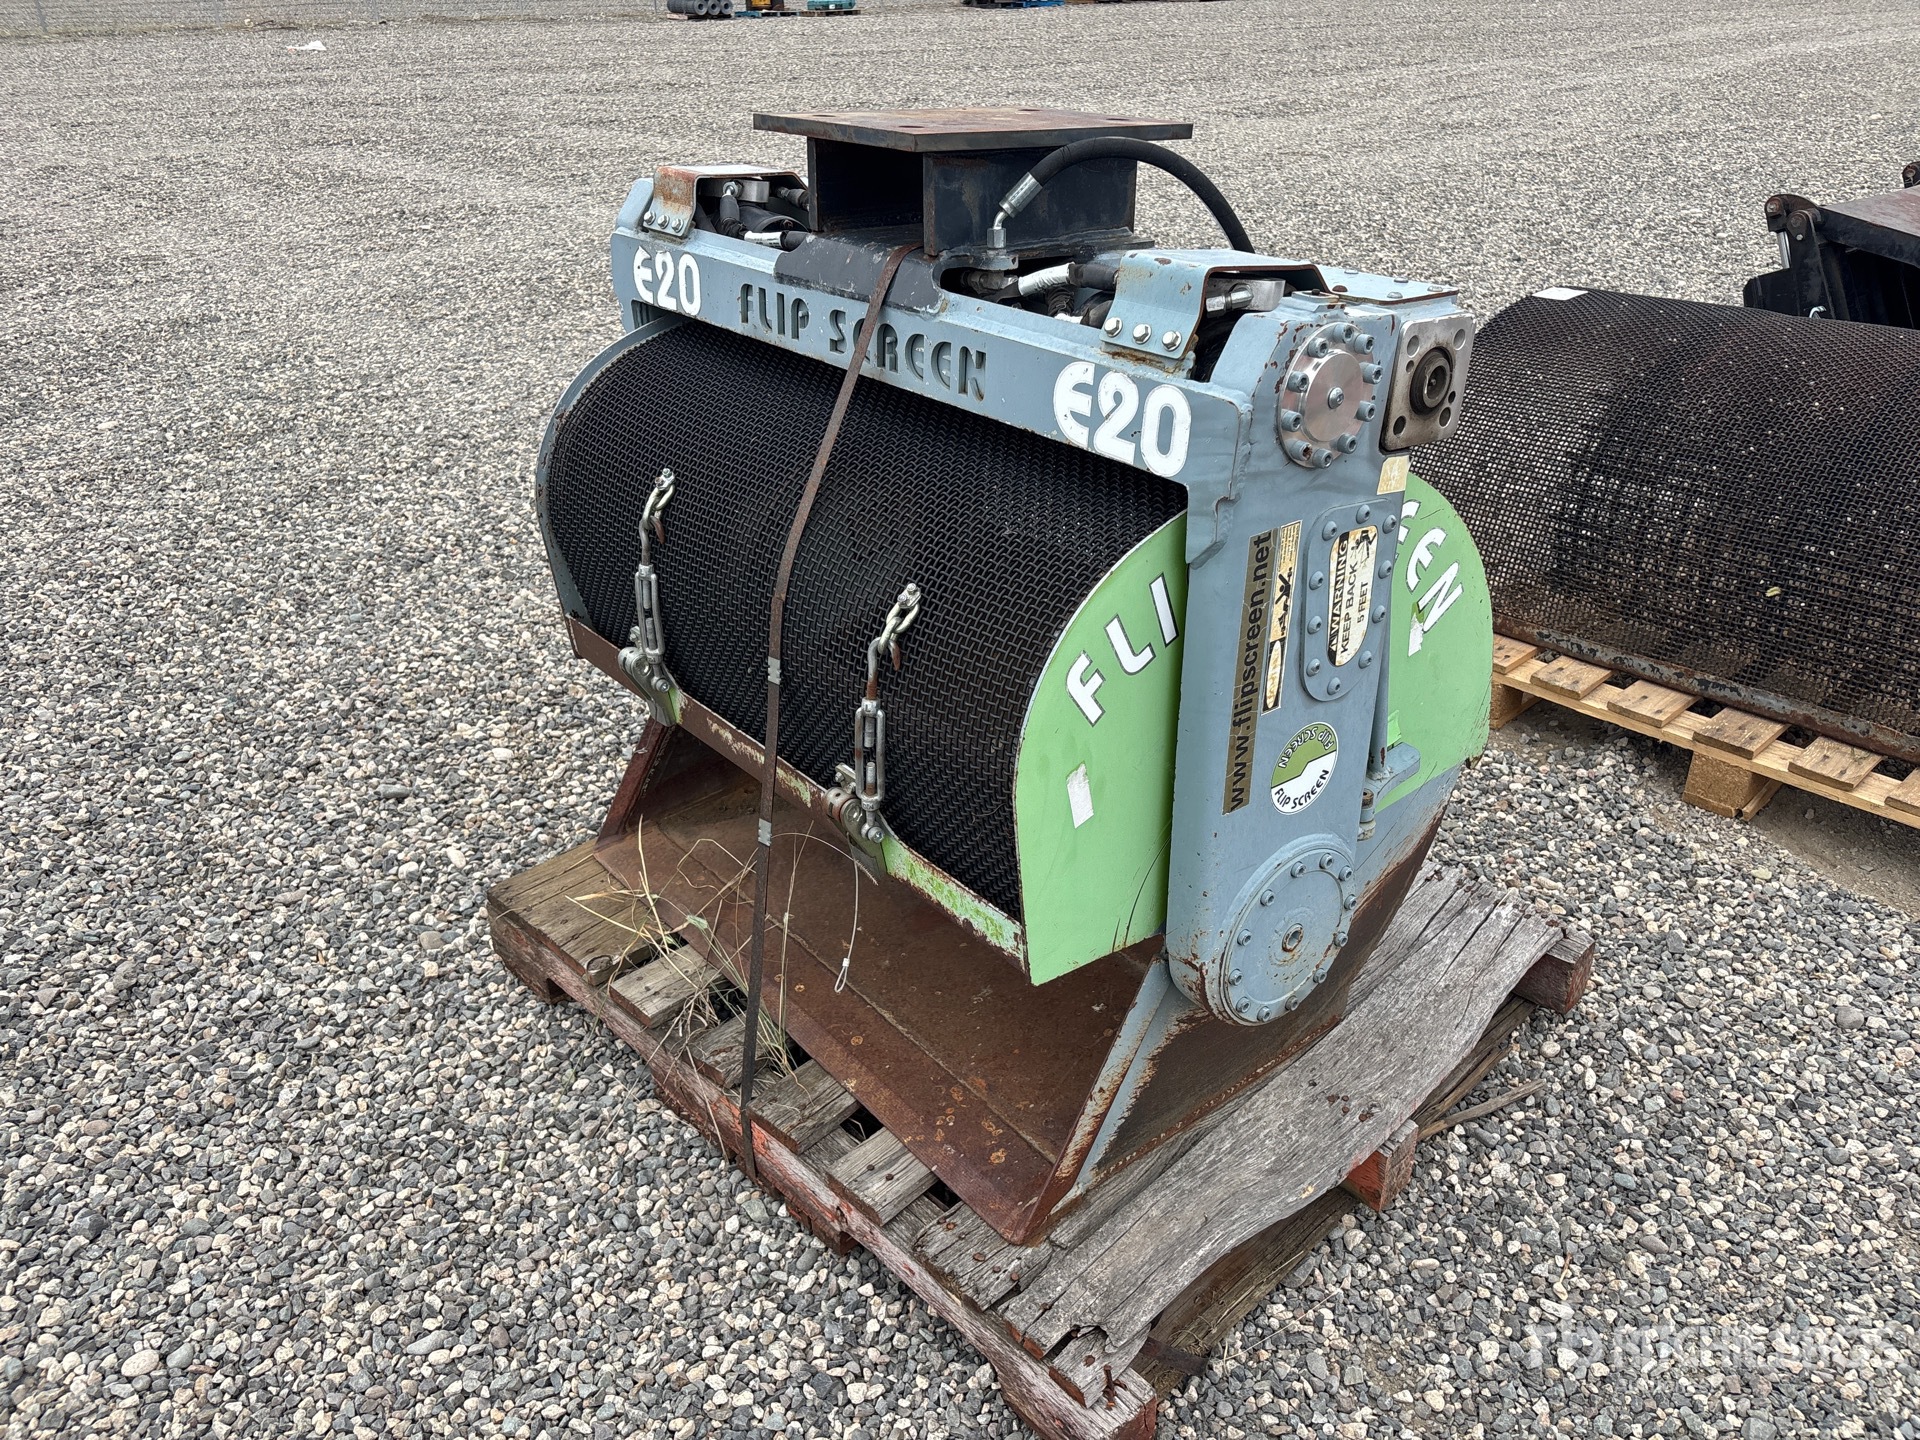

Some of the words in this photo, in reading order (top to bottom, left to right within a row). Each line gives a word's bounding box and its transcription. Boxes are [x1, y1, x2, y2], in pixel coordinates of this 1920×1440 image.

[633, 246, 701, 316] E20
[739, 284, 809, 340] FLIP
[1053, 361, 1191, 478] E20
[1331, 539, 1348, 635] WARNING
[1340, 613, 1352, 654] KEEP
[1346, 562, 1357, 608] BACK
[1358, 582, 1369, 613] FEET
[1357, 614, 1365, 624] 5
[1230, 531, 1272, 811] www.flipscreen.net
[1278, 727, 1318, 768] SCREEN
[1317, 729, 1334, 750] FLIP
[1275, 788, 1291, 807] FLIP
[1291, 769, 1329, 809] SCREEN
